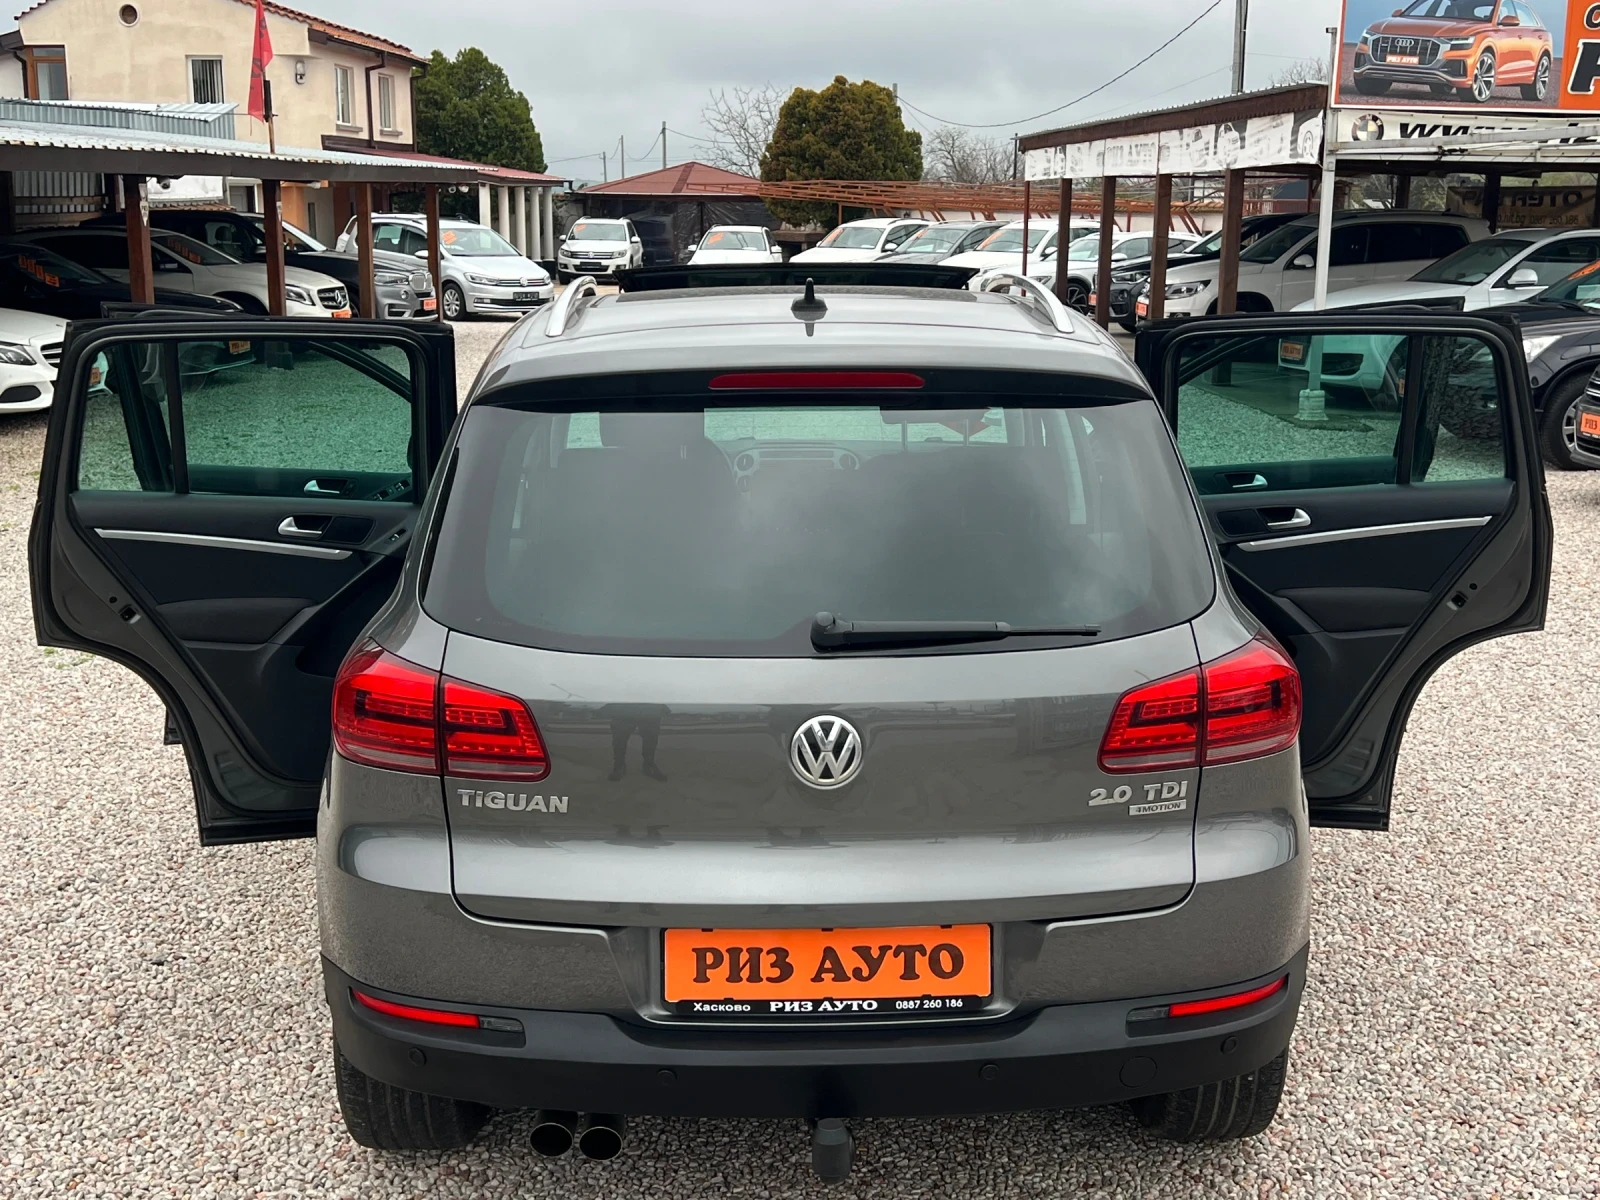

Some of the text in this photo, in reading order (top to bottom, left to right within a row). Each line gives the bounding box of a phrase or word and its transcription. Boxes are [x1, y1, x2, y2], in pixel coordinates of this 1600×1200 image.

[1143, 780, 1188, 801] TDI
[1135, 803, 1181, 813] 4MOTION
[692, 943, 964, 983] РИЗ АУТО
[693, 999, 963, 1012] Хасково РИЗ АУТО 0887 260 186
